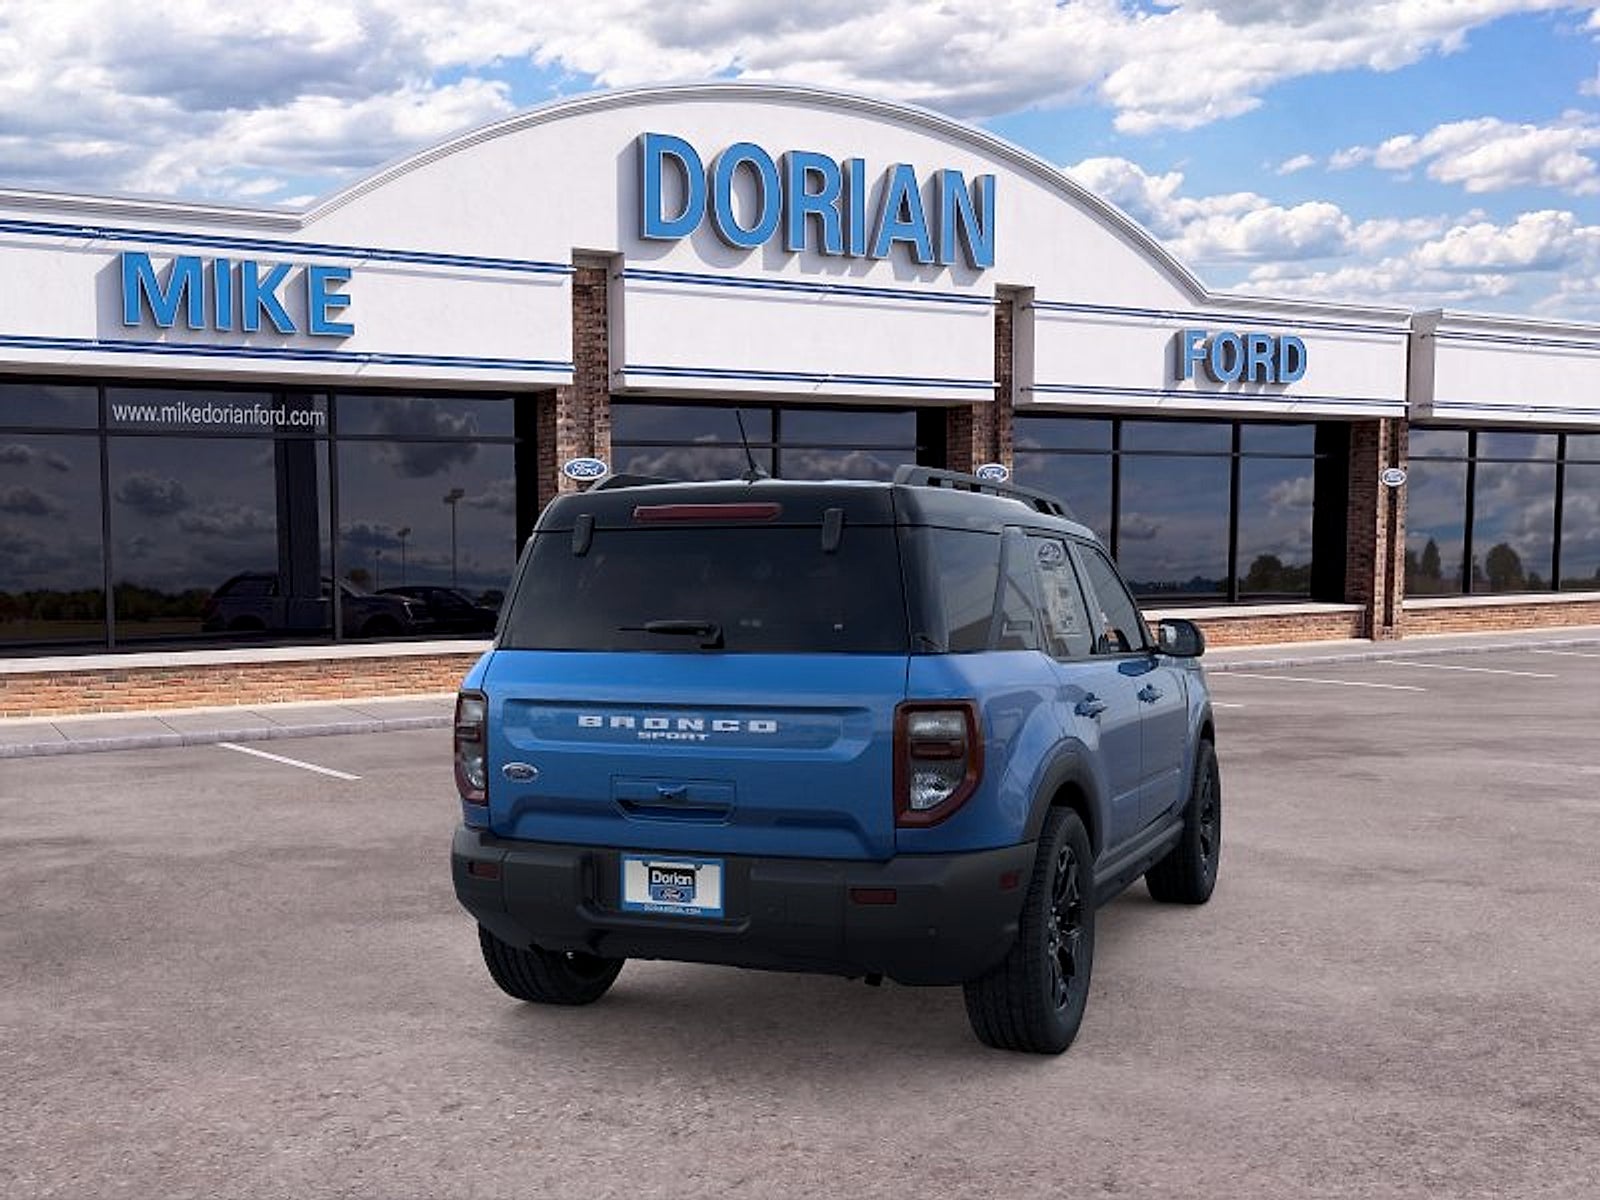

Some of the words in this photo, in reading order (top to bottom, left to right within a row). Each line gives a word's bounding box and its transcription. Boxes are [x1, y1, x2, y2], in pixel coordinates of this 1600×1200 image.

[640, 132, 995, 269] DORIAN
[122, 251, 355, 337] MIKE
[1177, 328, 1307, 384] FORD
[112, 402, 326, 426] www.mikedorianford.com
[578, 715, 778, 733] BRONCO
[638, 731, 710, 741] SPORT
[652, 870, 693, 885] Dorian
